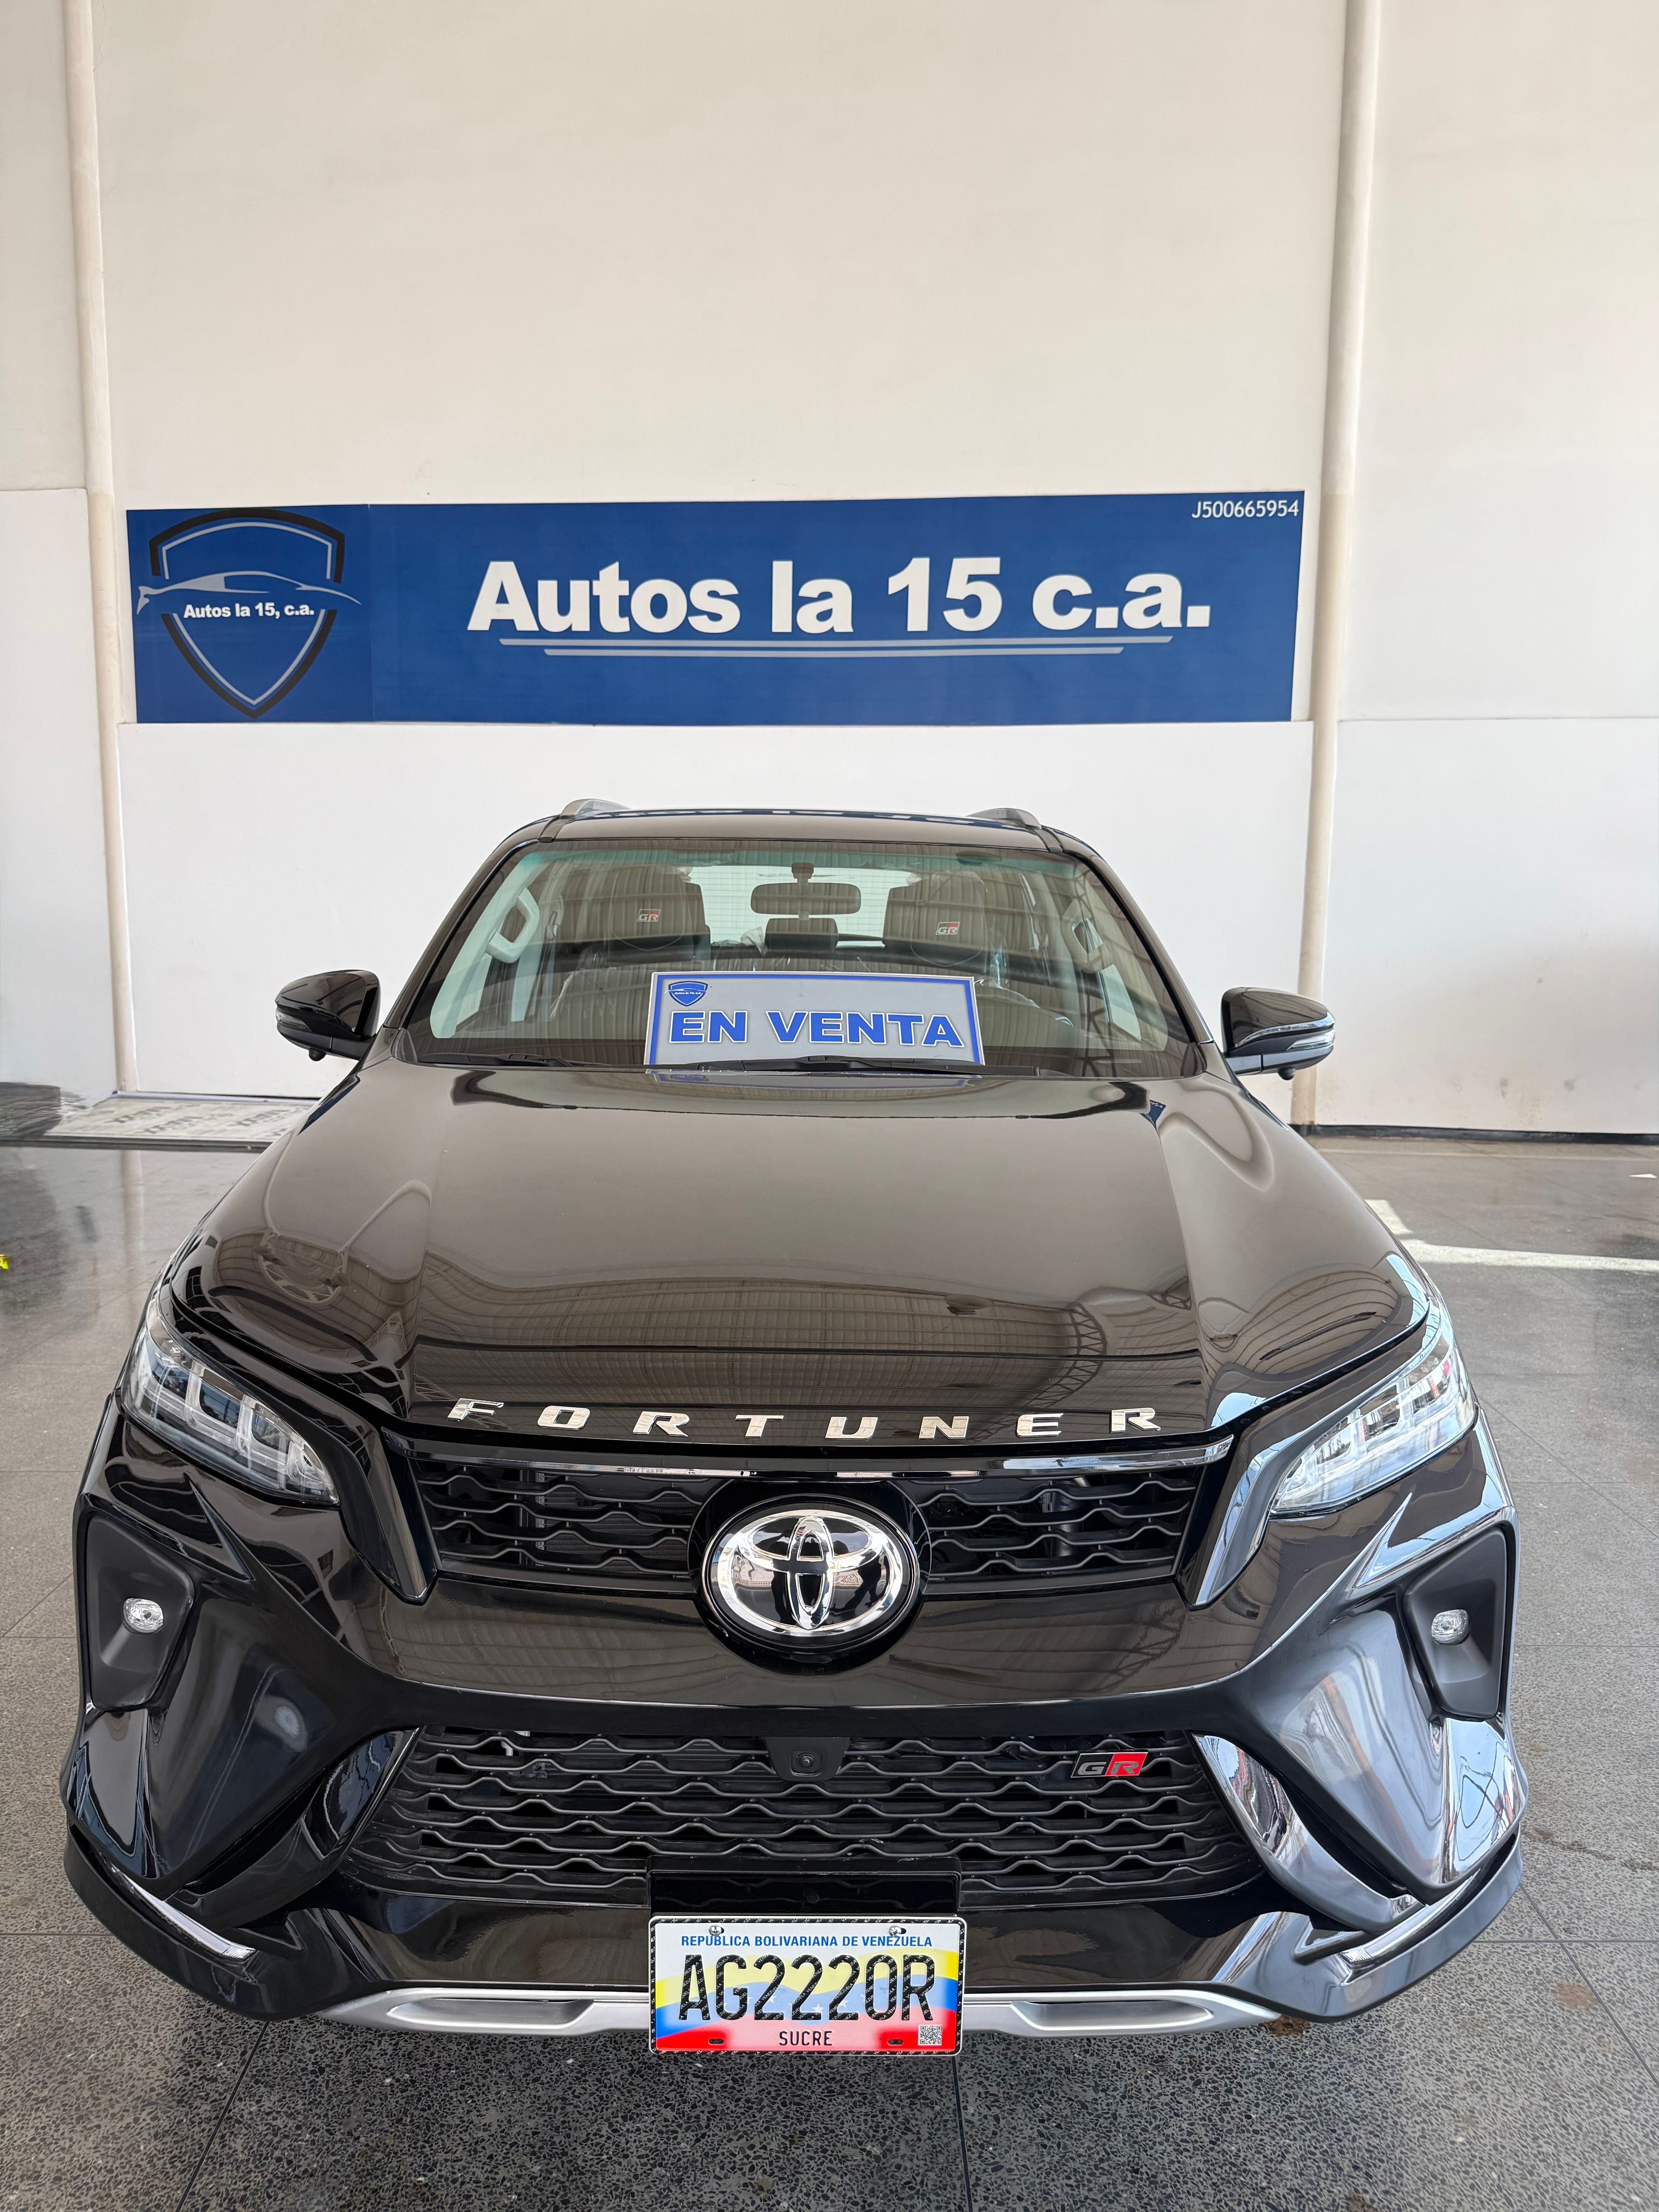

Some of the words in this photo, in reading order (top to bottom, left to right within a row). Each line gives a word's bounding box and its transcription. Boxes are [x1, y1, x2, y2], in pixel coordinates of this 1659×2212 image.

[1192, 500, 1299, 518] J500665954
[467, 560, 740, 634] Autos
[771, 560, 853, 634] la
[888, 557, 1002, 632] 15
[1032, 573, 1211, 630] c.a.
[184, 605, 231, 618] Autos
[235, 604, 250, 618] la
[255, 602, 280, 619] 15,
[284, 604, 314, 616] c.a.
[669, 1011, 747, 1043] EN
[766, 1011, 965, 1048] VENTA
[447, 1397, 1162, 1440] FORTUNER
[1077, 1761, 1139, 1775] GR
[755, 1936, 838, 1946] BOLIVARIANA
[843, 1936, 858, 1946] DE
[862, 1936, 933, 1947] VENEZUELA
[779, 2031, 832, 2046] SUCRE
